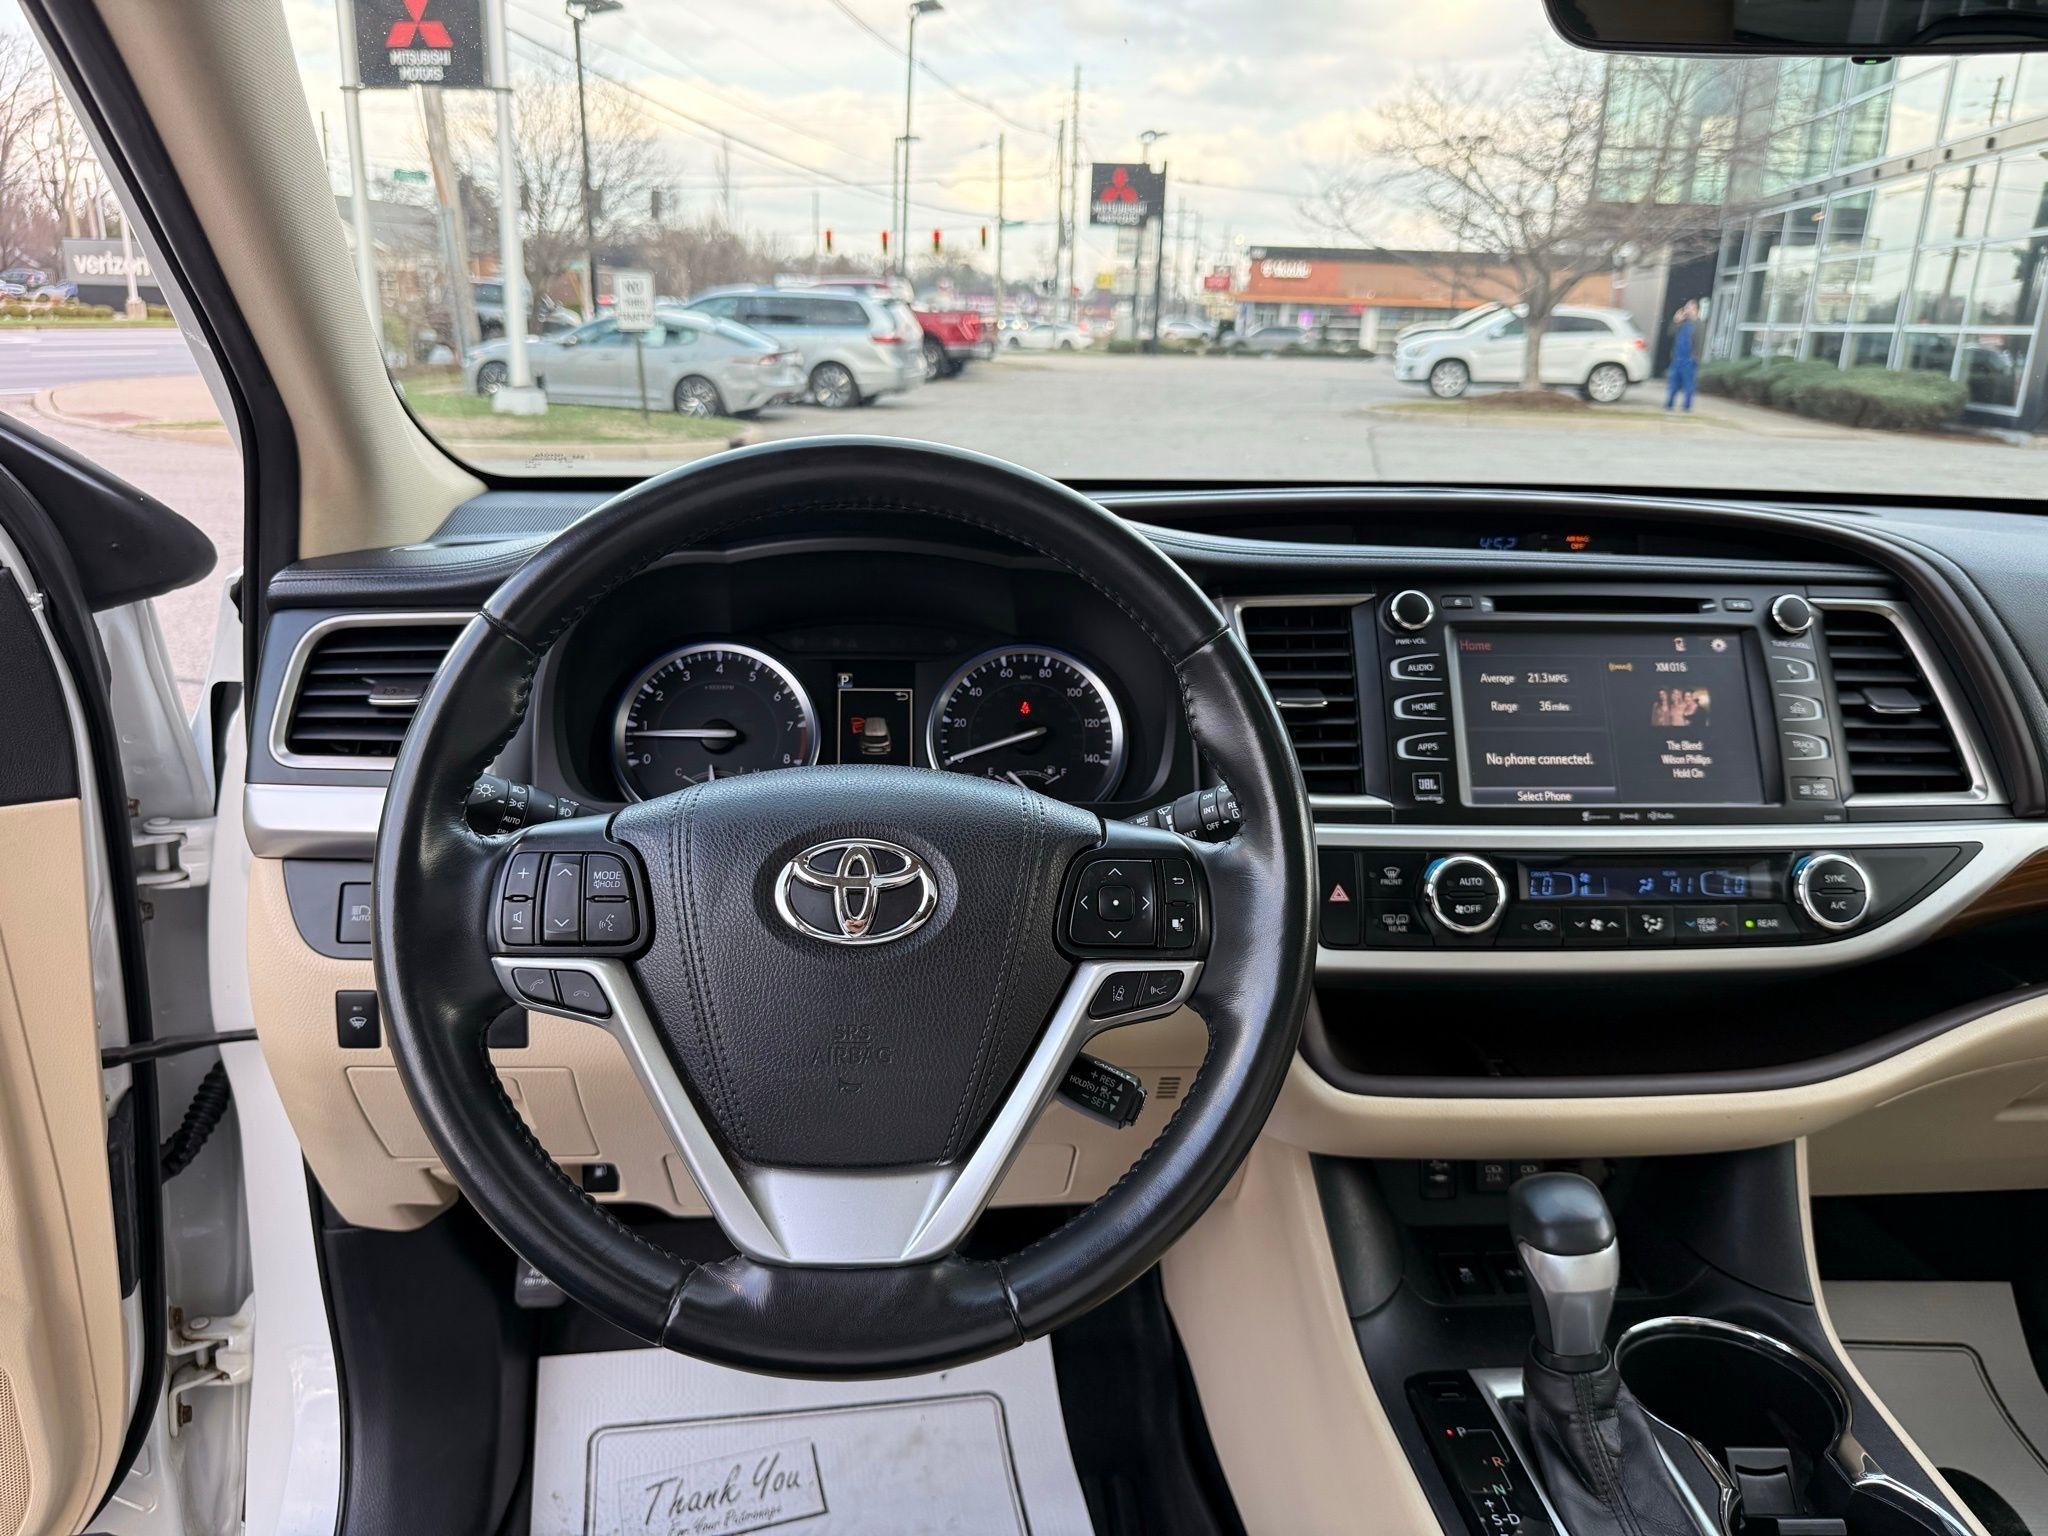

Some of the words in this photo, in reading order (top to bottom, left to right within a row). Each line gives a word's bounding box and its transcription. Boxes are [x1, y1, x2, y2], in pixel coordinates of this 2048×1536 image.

[389, 49, 451, 65] MITSUBISHI
[398, 66, 444, 81] MOTORS
[1459, 640, 1491, 651] Home
[716, 664, 724, 674] 4
[1408, 664, 1434, 672] AUDIO
[683, 672, 691, 682] 3
[750, 672, 757, 682] 5
[1000, 669, 1014, 678] 60
[1039, 669, 1053, 679] 80
[841, 674, 849, 686] P
[1480, 673, 1516, 685] Average
[656, 692, 664, 702] 2
[774, 692, 782, 702] 6
[969, 687, 983, 697] 40
[1067, 687, 1083, 698] 100
[1411, 703, 1437, 711] HOME
[1491, 701, 1519, 713] Range
[786, 721, 794, 731] 7
[954, 718, 967, 728] 20
[1084, 718, 1100, 728] 120
[1417, 743, 1439, 751] APPS
[1666, 740, 1680, 750] The
[643, 754, 652, 764] 0
[783, 754, 791, 764] 8
[1084, 754, 1100, 764] 140
[1486, 753, 1502, 765] No
[1505, 753, 1536, 767] phone
[1538, 753, 1594, 765] connected.
[675, 767, 682, 776] C
[988, 767, 994, 776] E
[1061, 767, 1068, 776] F
[1202, 792, 1213, 800] ON
[1517, 791, 1543, 801] Select
[1544, 791, 1572, 801] Phone
[1203, 805, 1215, 814] INT
[503, 815, 520, 825] AUTO
[1206, 821, 1219, 831] OFF
[593, 871, 621, 880] MODE
[1824, 874, 1846, 883] SYNC
[1460, 878, 1482, 886] AUTO
[1464, 905, 1481, 913] OFF
[1830, 901, 1847, 909] A/C
[1757, 919, 1779, 927] REAR
[1094, 1060, 1127, 1079] CANCEL
[1099, 1074, 1116, 1088] RES
[1090, 1096, 1106, 1109] SET
[1456, 1426, 1466, 1438] P
[1491, 1456, 1505, 1468] R
[645, 1464, 741, 1526] Thank
[752, 1451, 801, 1499] You
[1492, 1484, 1507, 1496] N
